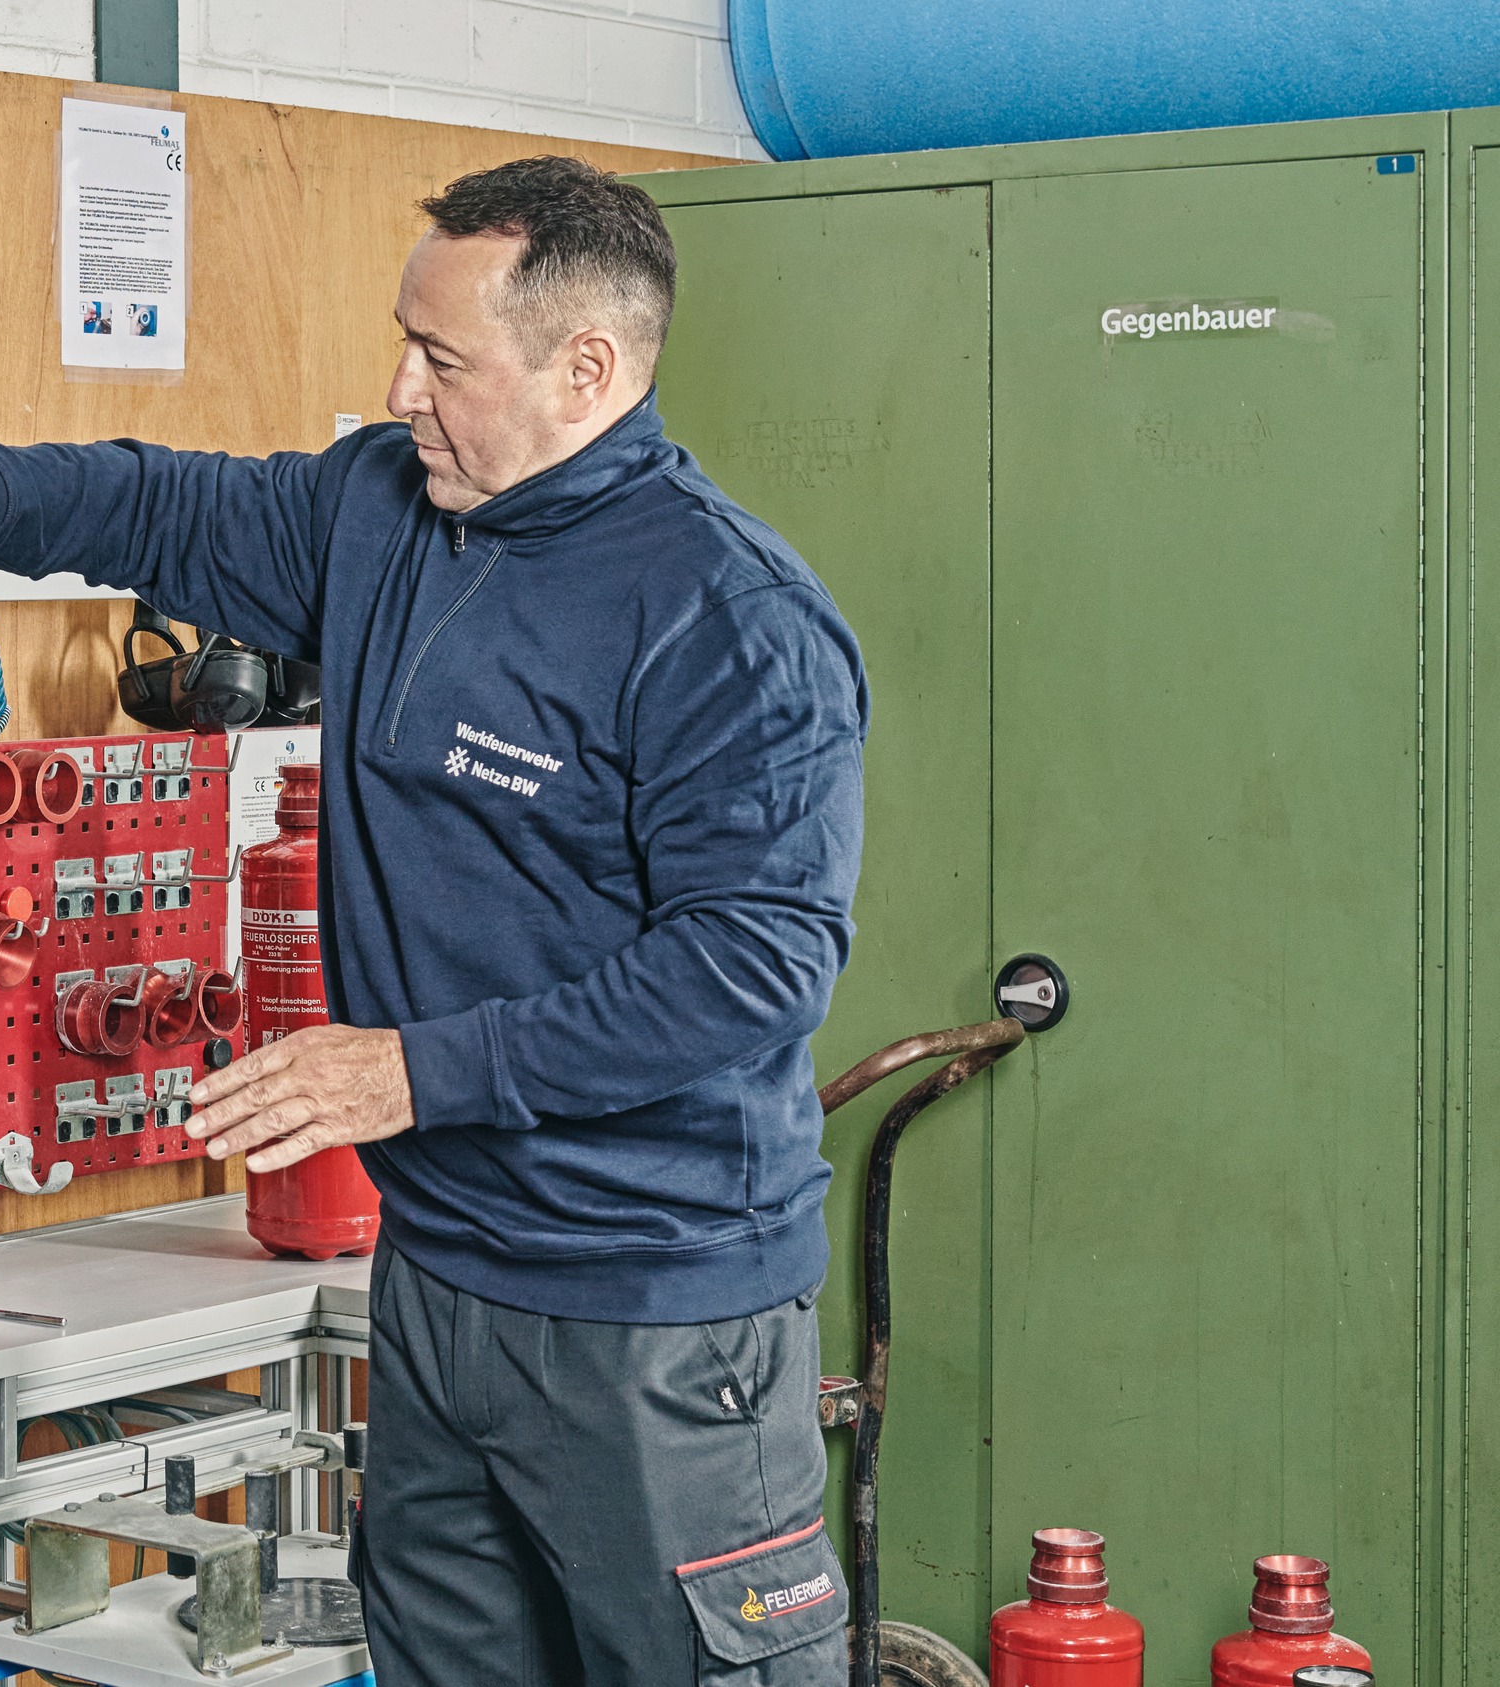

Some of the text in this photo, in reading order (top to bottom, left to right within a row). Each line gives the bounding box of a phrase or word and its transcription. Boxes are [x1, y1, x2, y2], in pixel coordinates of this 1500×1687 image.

[150, 138, 180, 148] FEUMAT
[1391, 157, 1398, 172] 1
[1101, 304, 1276, 339] Gegenbauer
[456, 721, 563, 773] Werkfeuerwehr
[471, 760, 541, 798] Netze BW
[244, 931, 317, 944] FEUERLÖSCHER
[261, 965, 291, 974] Sicherung
[292, 965, 318, 973] ziehen!
[261, 996, 278, 1004] Knopf
[280, 997, 321, 1007] einschlagen
[261, 1005, 300, 1014] Löschpistole
[764, 1572, 834, 1612] FEUERWEHR
